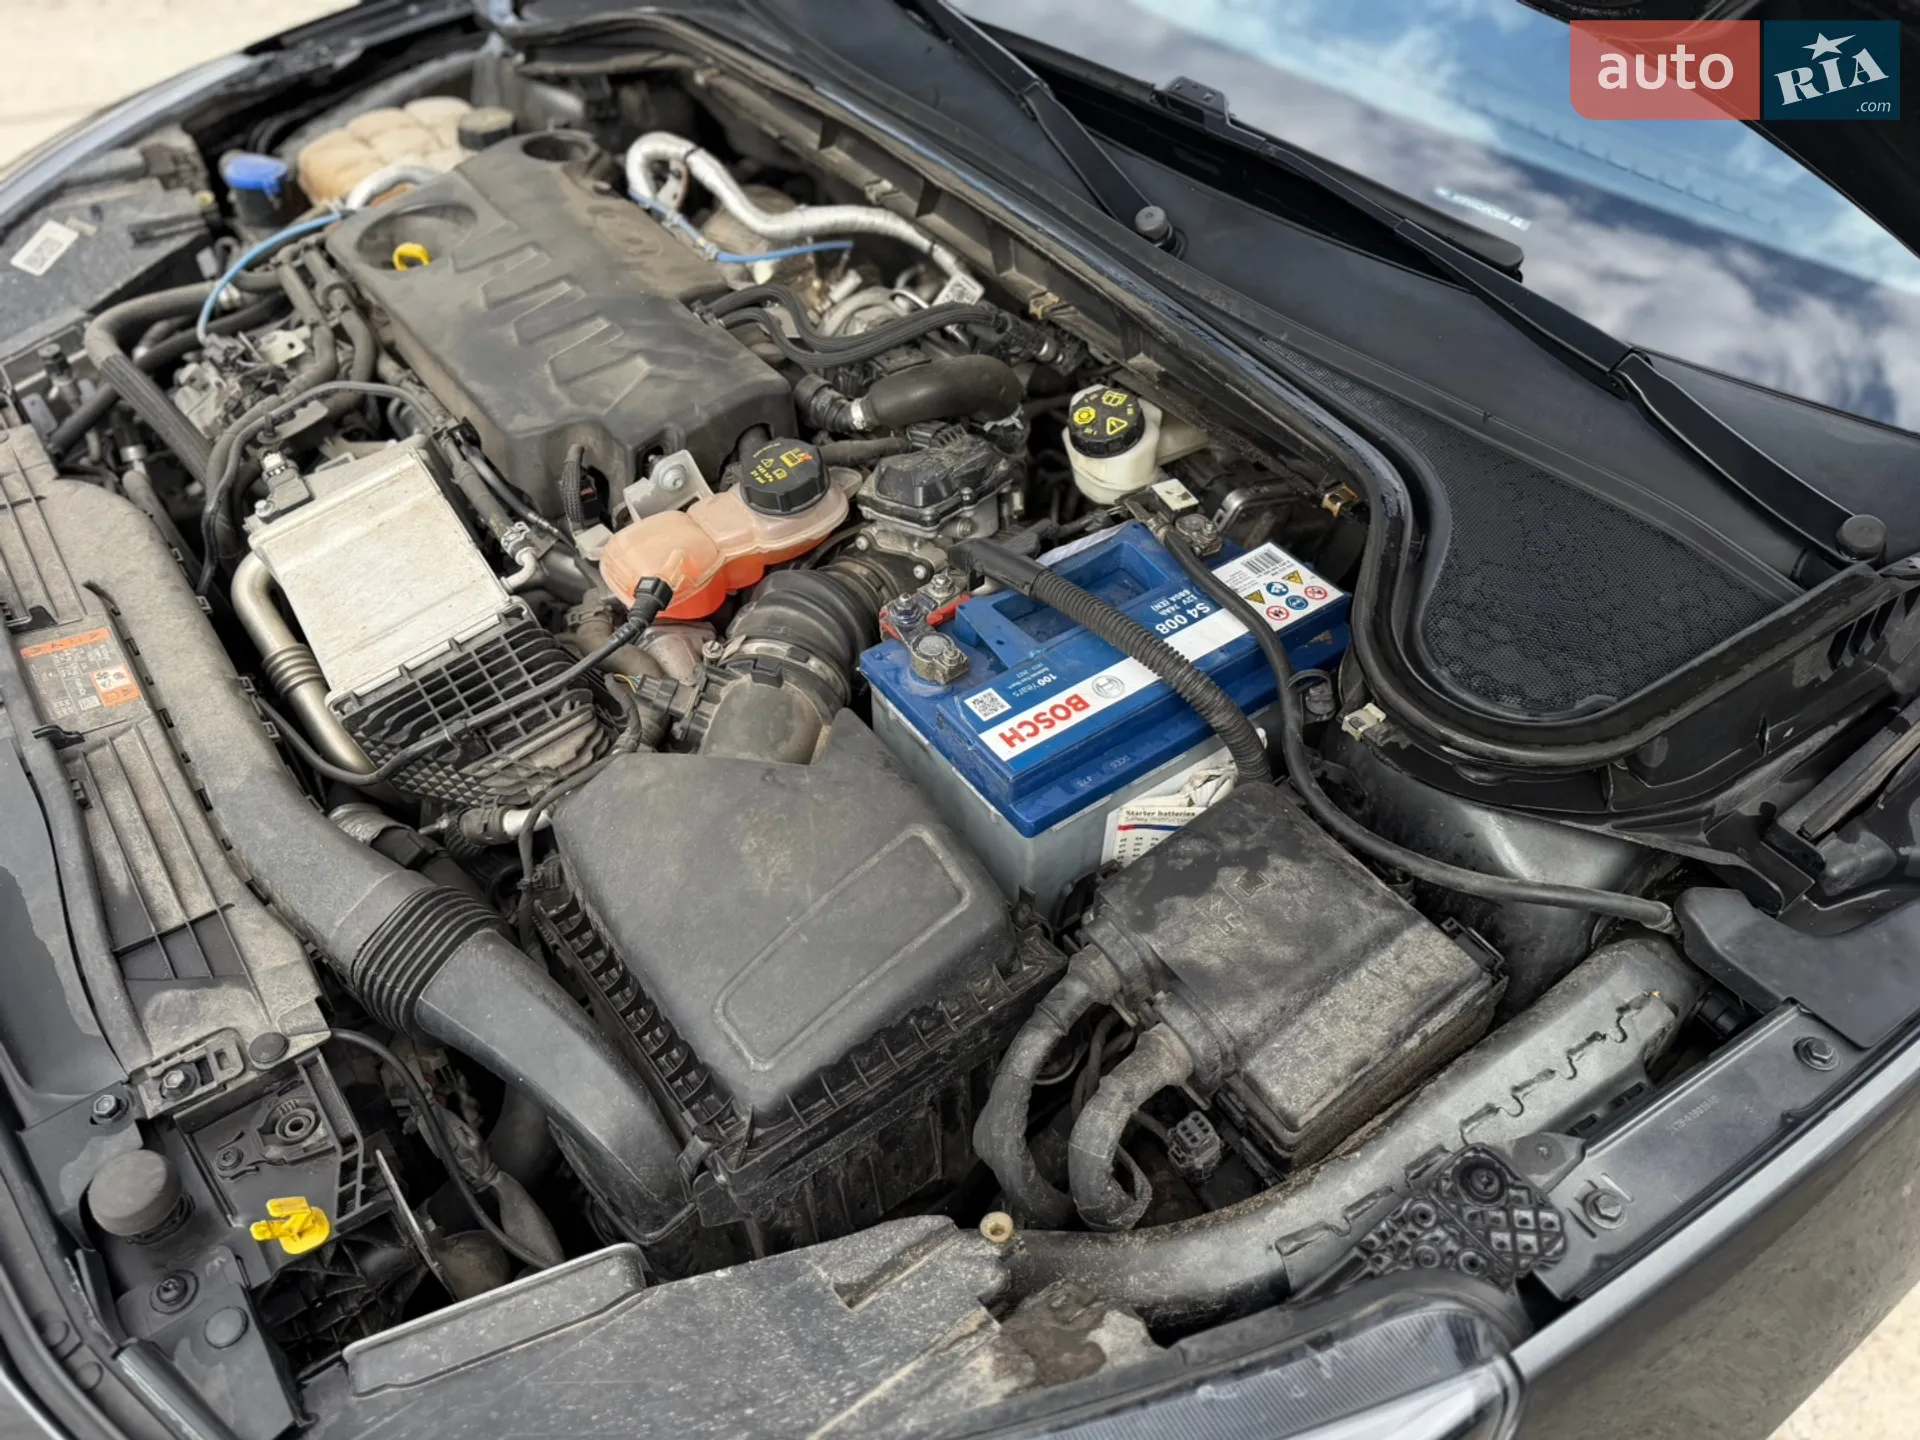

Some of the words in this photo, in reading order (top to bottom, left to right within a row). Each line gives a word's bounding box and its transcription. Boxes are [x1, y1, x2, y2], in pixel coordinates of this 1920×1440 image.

[1182, 594, 1198, 605] 12V
[1186, 602, 1211, 619] S4
[1155, 614, 1188, 634] 008
[1037, 673, 1057, 687] 100
[1012, 683, 1040, 698] Years
[998, 693, 1090, 748] BOSCH
[1125, 809, 1155, 817] Starter
[1157, 809, 1196, 818] batteries
